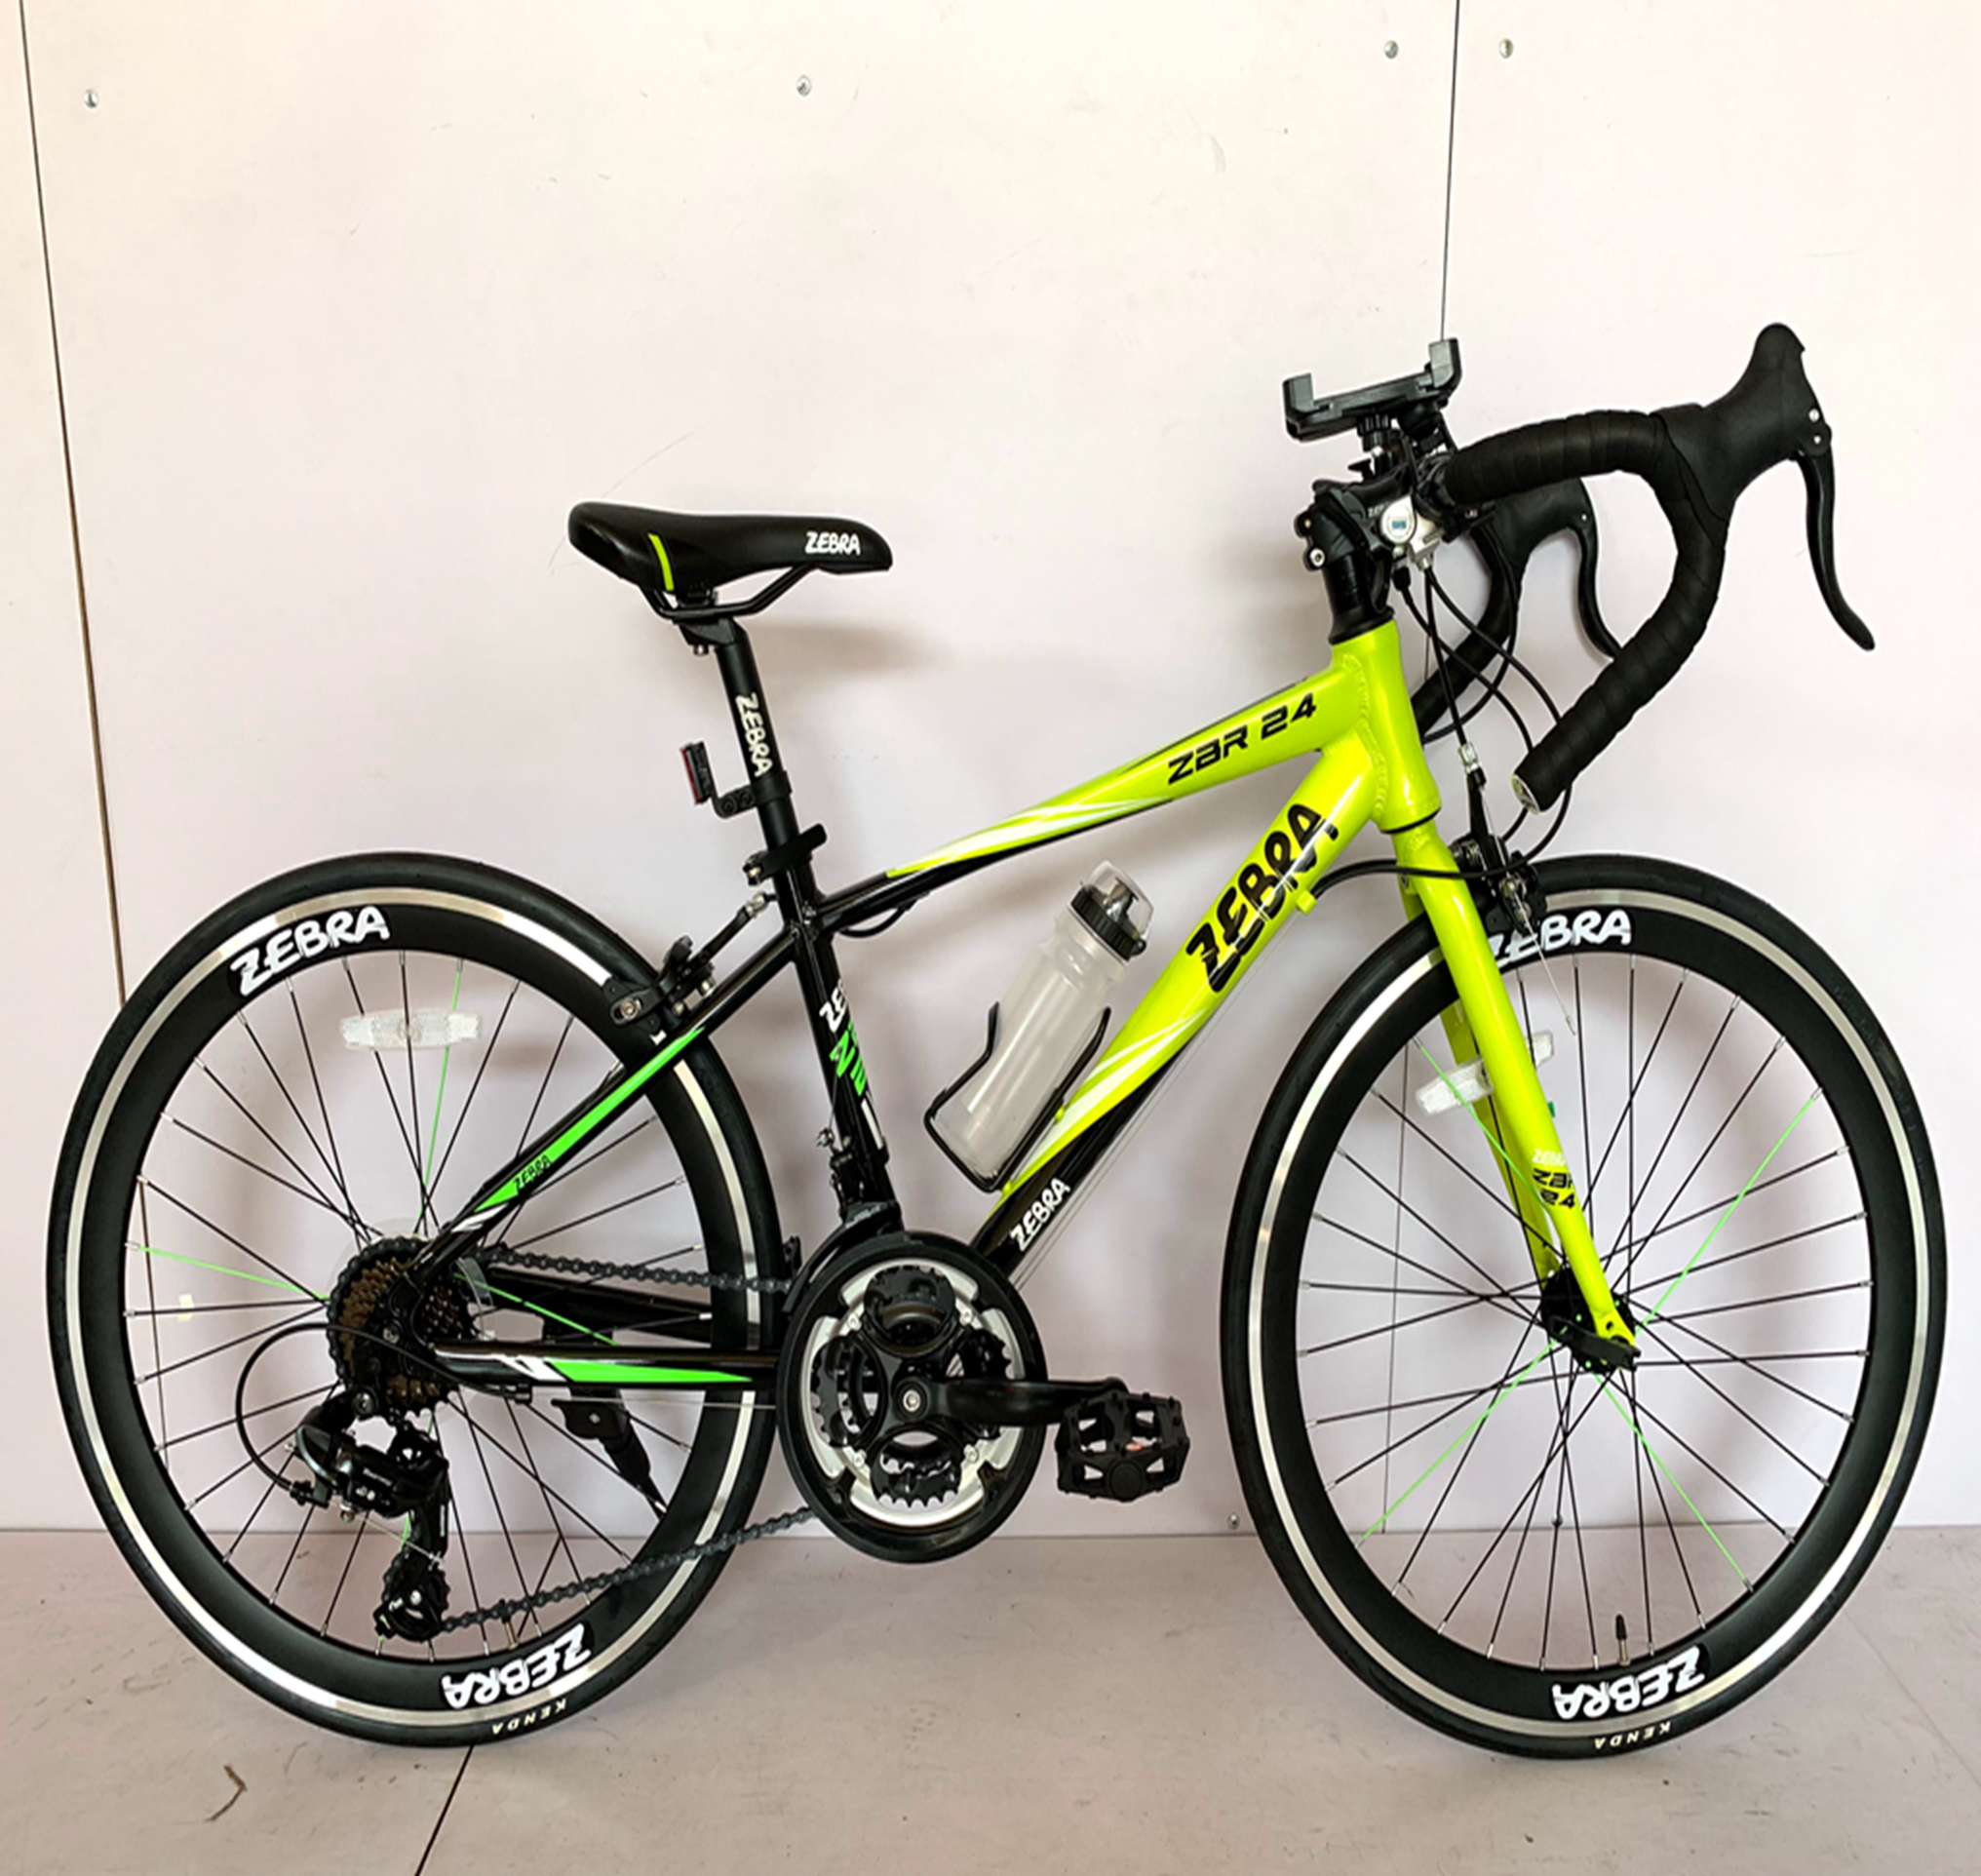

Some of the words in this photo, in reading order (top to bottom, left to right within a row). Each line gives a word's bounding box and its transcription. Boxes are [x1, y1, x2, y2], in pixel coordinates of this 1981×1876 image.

[804, 530, 861, 556] ZEBRA
[735, 692, 773, 777] ZEBRA
[1261, 692, 1316, 740] 24
[1185, 803, 1339, 993] ZEBRA
[230, 906, 390, 996] ZEBRA
[512, 1154, 552, 1190] ZEBRA
[1010, 1177, 1070, 1251] ZEBRA
[442, 1623, 591, 1709] ZEBRA
[1552, 1645, 1705, 1719] ZEBRA
[491, 1698, 567, 1735] KENDA
[1595, 1720, 1671, 1750] KENDA
